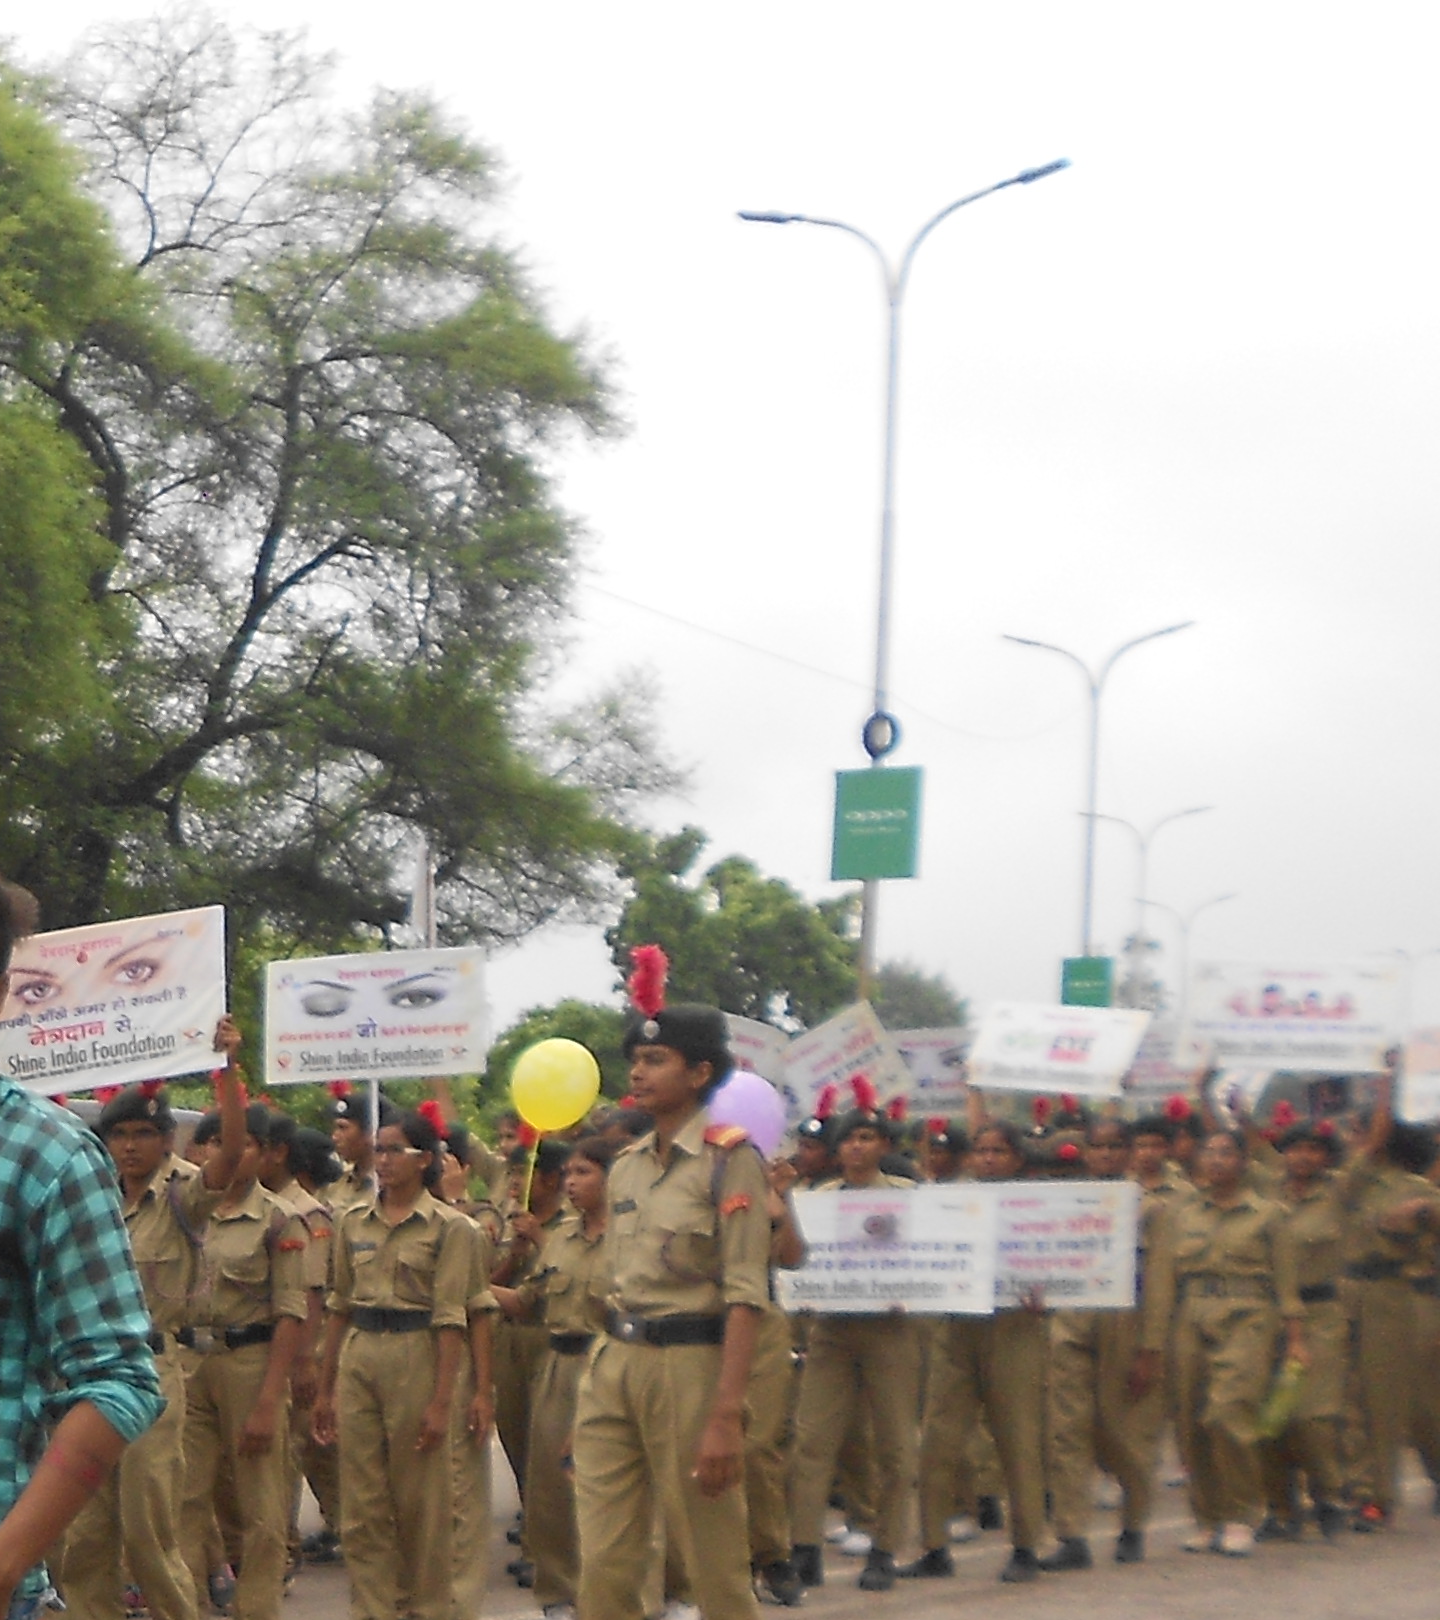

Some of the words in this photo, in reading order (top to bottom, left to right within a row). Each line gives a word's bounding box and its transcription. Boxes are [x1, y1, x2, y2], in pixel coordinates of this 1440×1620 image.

[27, 1019, 105, 1048] नेत्रदान
[8, 1053, 47, 1076] Shine
[51, 1045, 88, 1069] India
[92, 1032, 176, 1062] Foundation
[300, 1048, 333, 1066] Shine
[373, 1044, 444, 1063] Foundation
